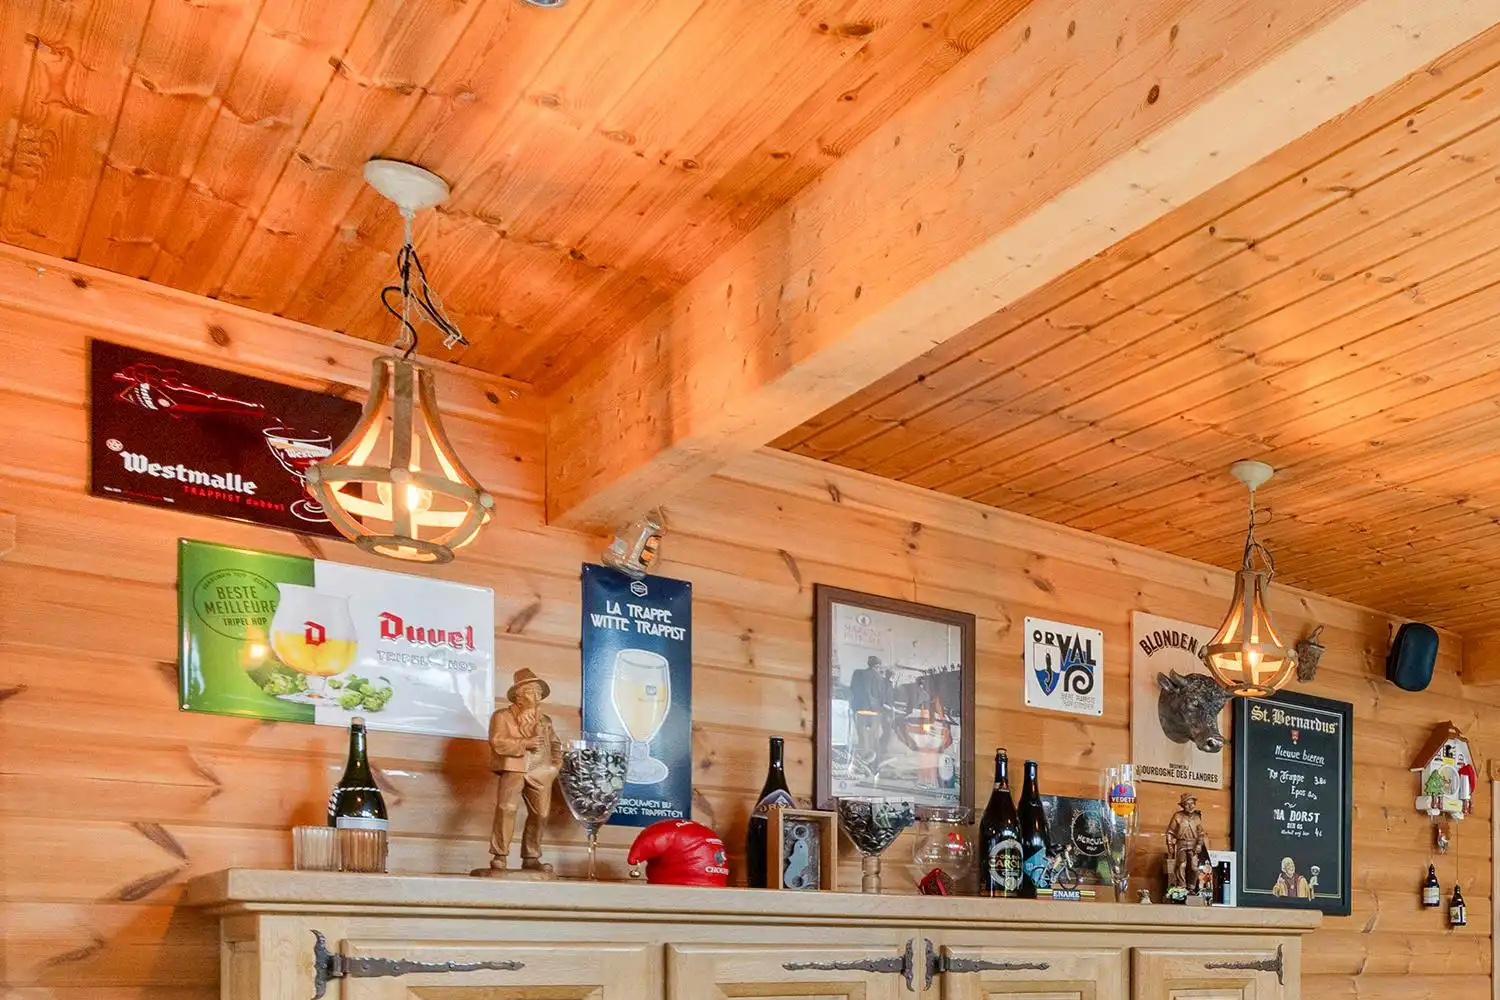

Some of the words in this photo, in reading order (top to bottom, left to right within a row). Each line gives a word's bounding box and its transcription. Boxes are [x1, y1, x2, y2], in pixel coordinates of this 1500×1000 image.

[120, 451, 257, 495] Westmalle
[183, 485, 241, 503] TRAPPIST
[216, 585, 258, 600] BESTE
[204, 600, 277, 615] MEILLEURE
[606, 600, 622, 615] LA
[626, 603, 672, 623] TRAPPE
[221, 616, 249, 627] TRIPEL
[251, 617, 268, 626] HOP
[590, 613, 630, 631] WITTE
[634, 619, 686, 640] TRAPPIST
[303, 620, 327, 647] D
[377, 611, 476, 652] Duvel
[1033, 629, 1097, 666] ORVAL
[1139, 630, 1197, 657] BLONDEN
[1251, 705, 1270, 722] St.
[1272, 708, 1337, 734] Bernardus
[1275, 745, 1300, 760] Nieuwe
[1302, 749, 1325, 765] bieren
[1176, 769, 1188, 780] DES
[1188, 771, 1219, 783] FLANDRES
[613, 806, 638, 815] ATERS
[617, 798, 660, 808] BROUWEN
[1289, 810, 1320, 824] DORST
[1076, 834, 1104, 846] HERCUL
[1053, 890, 1081, 898] ENAME
